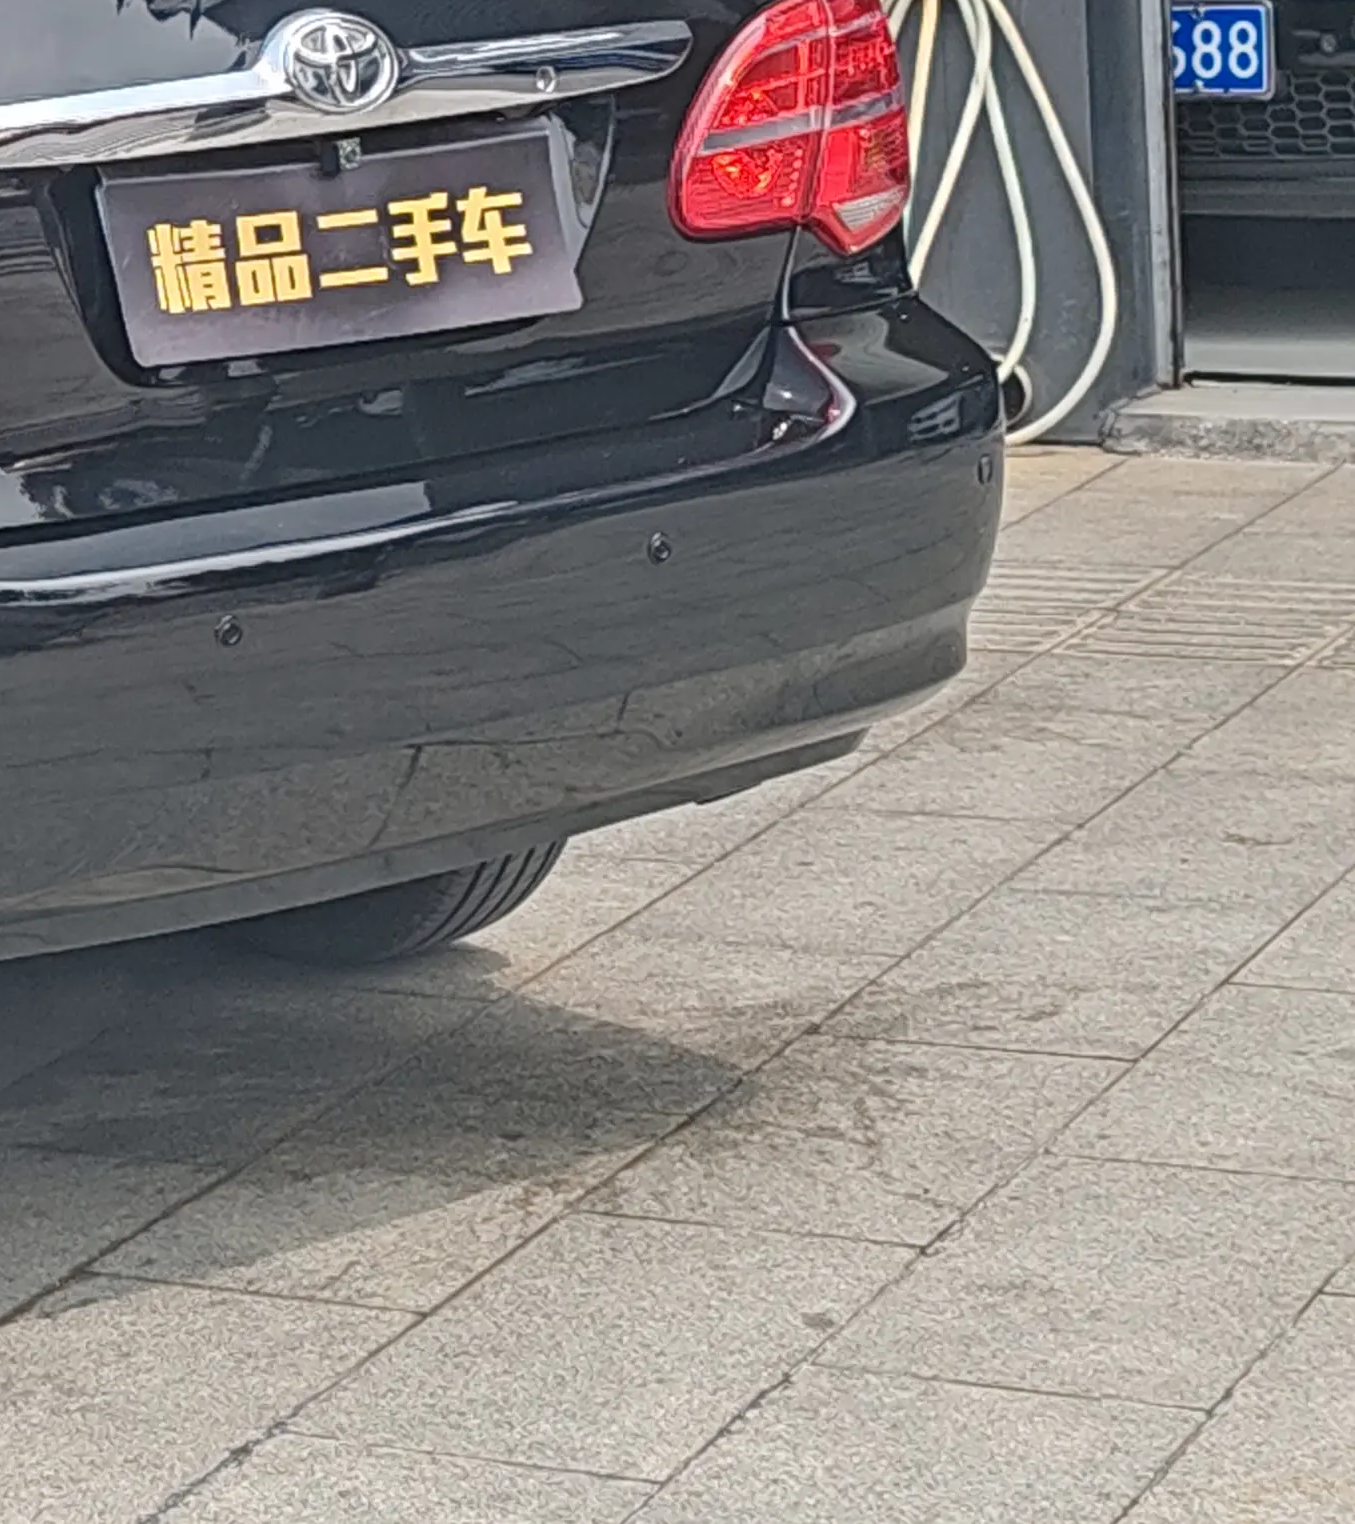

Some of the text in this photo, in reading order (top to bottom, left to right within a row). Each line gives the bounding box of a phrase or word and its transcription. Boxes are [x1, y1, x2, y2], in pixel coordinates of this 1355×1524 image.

[147, 185, 533, 314] 精品二手车
